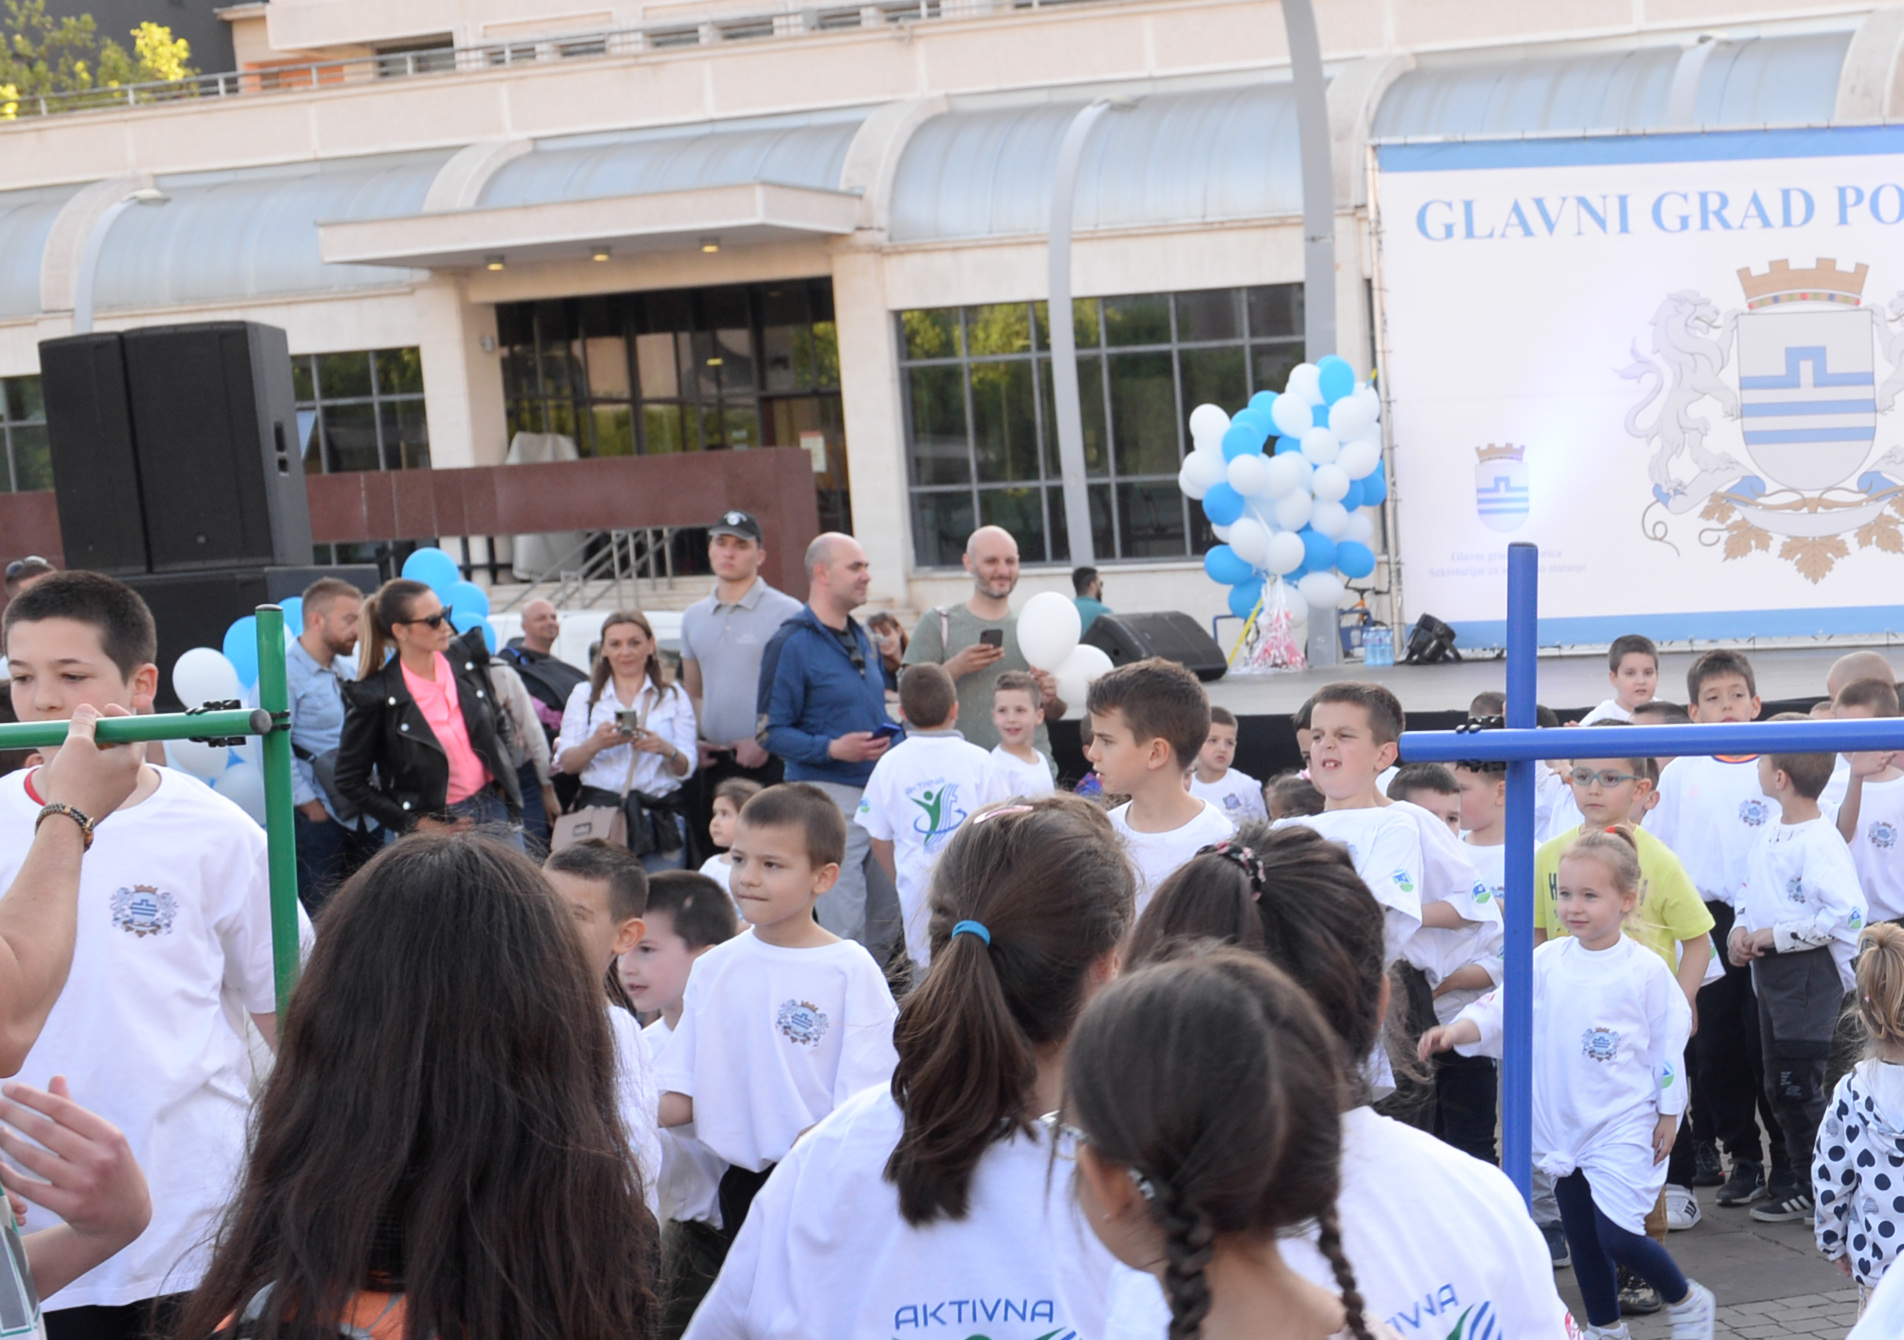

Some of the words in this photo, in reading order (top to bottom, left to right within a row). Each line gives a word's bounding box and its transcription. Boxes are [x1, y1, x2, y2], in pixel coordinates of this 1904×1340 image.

[1416, 193, 1633, 241] GLAVNI
[1651, 188, 1815, 234] GRAD
[894, 1298, 1055, 1331] AKTIVNA
